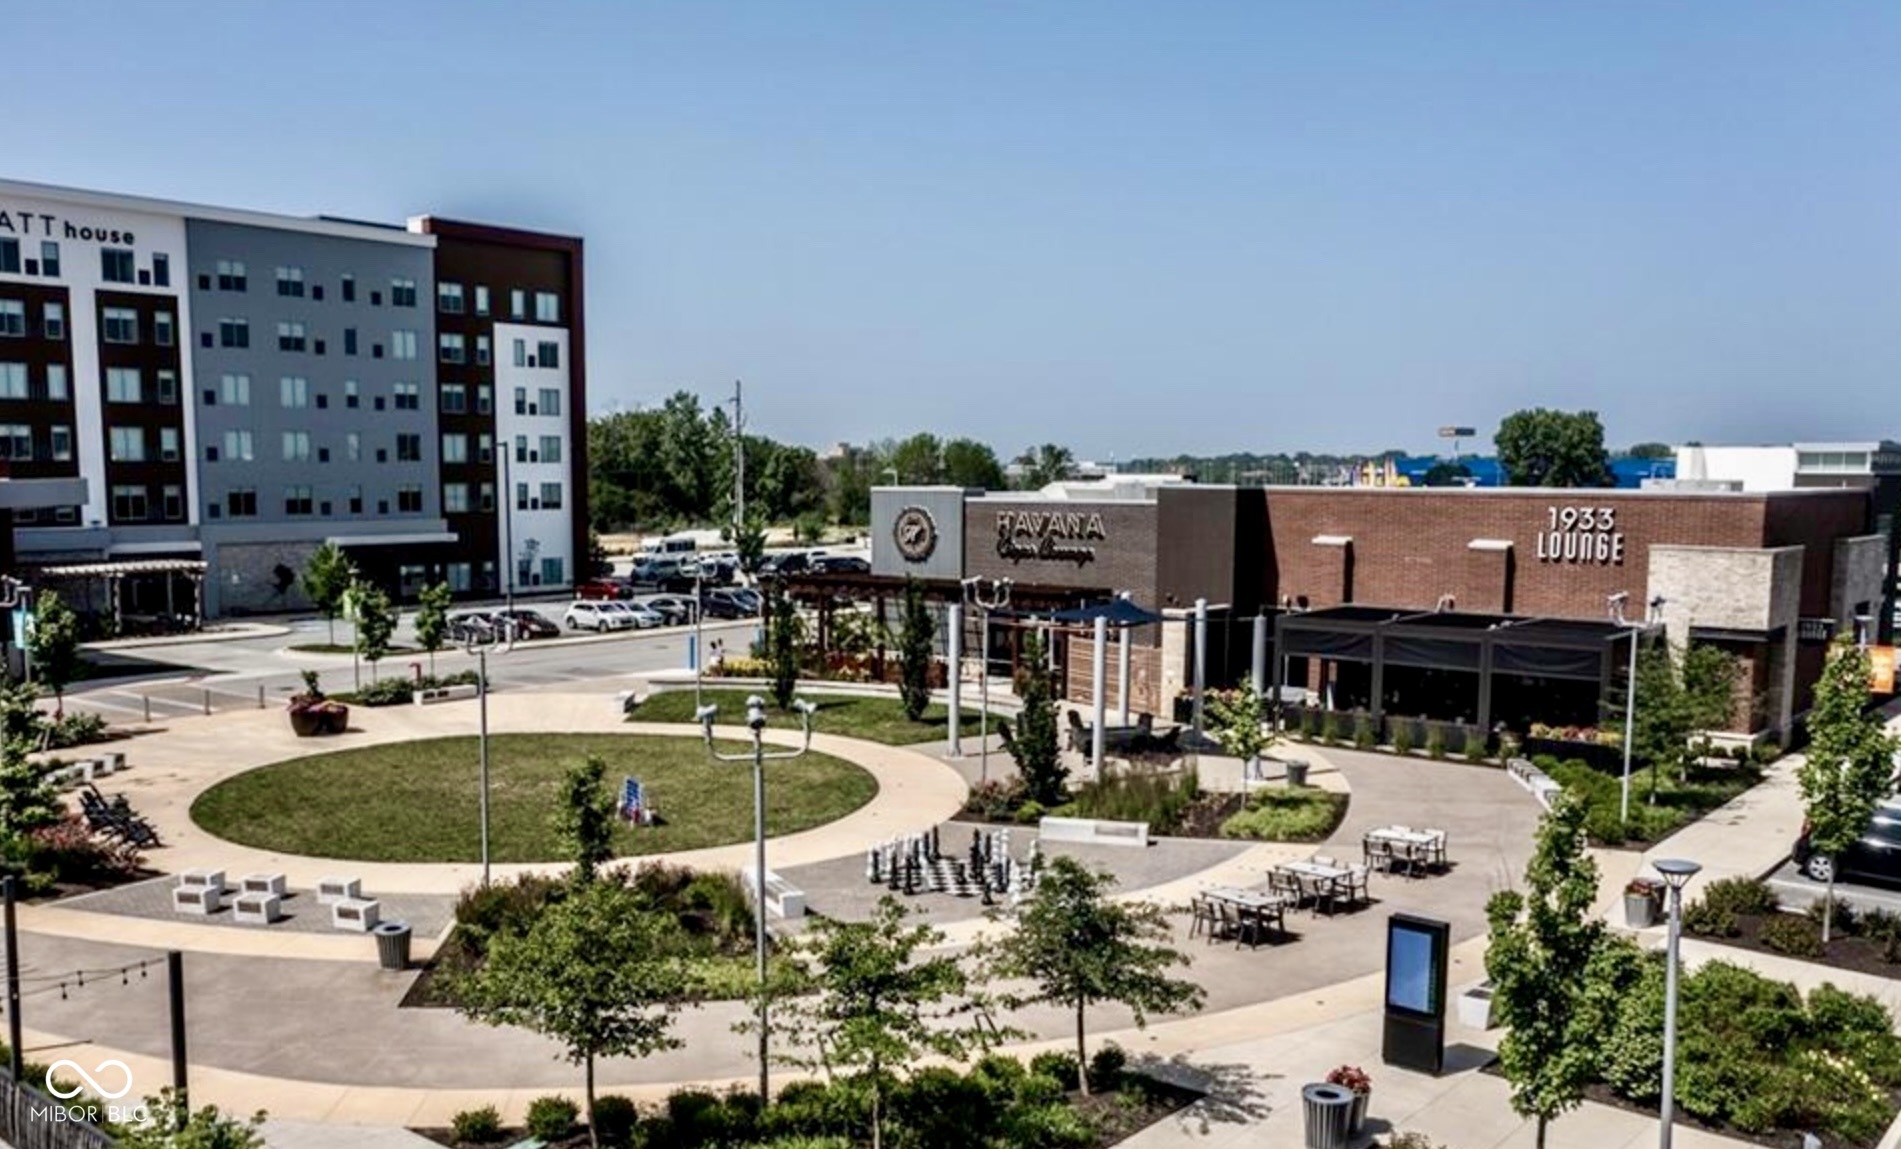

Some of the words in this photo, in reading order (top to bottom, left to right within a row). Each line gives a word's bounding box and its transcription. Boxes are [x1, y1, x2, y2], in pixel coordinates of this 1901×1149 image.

[64, 220, 135, 245] house
[996, 510, 1106, 538] HAVANA
[1548, 506, 1616, 532] 1933
